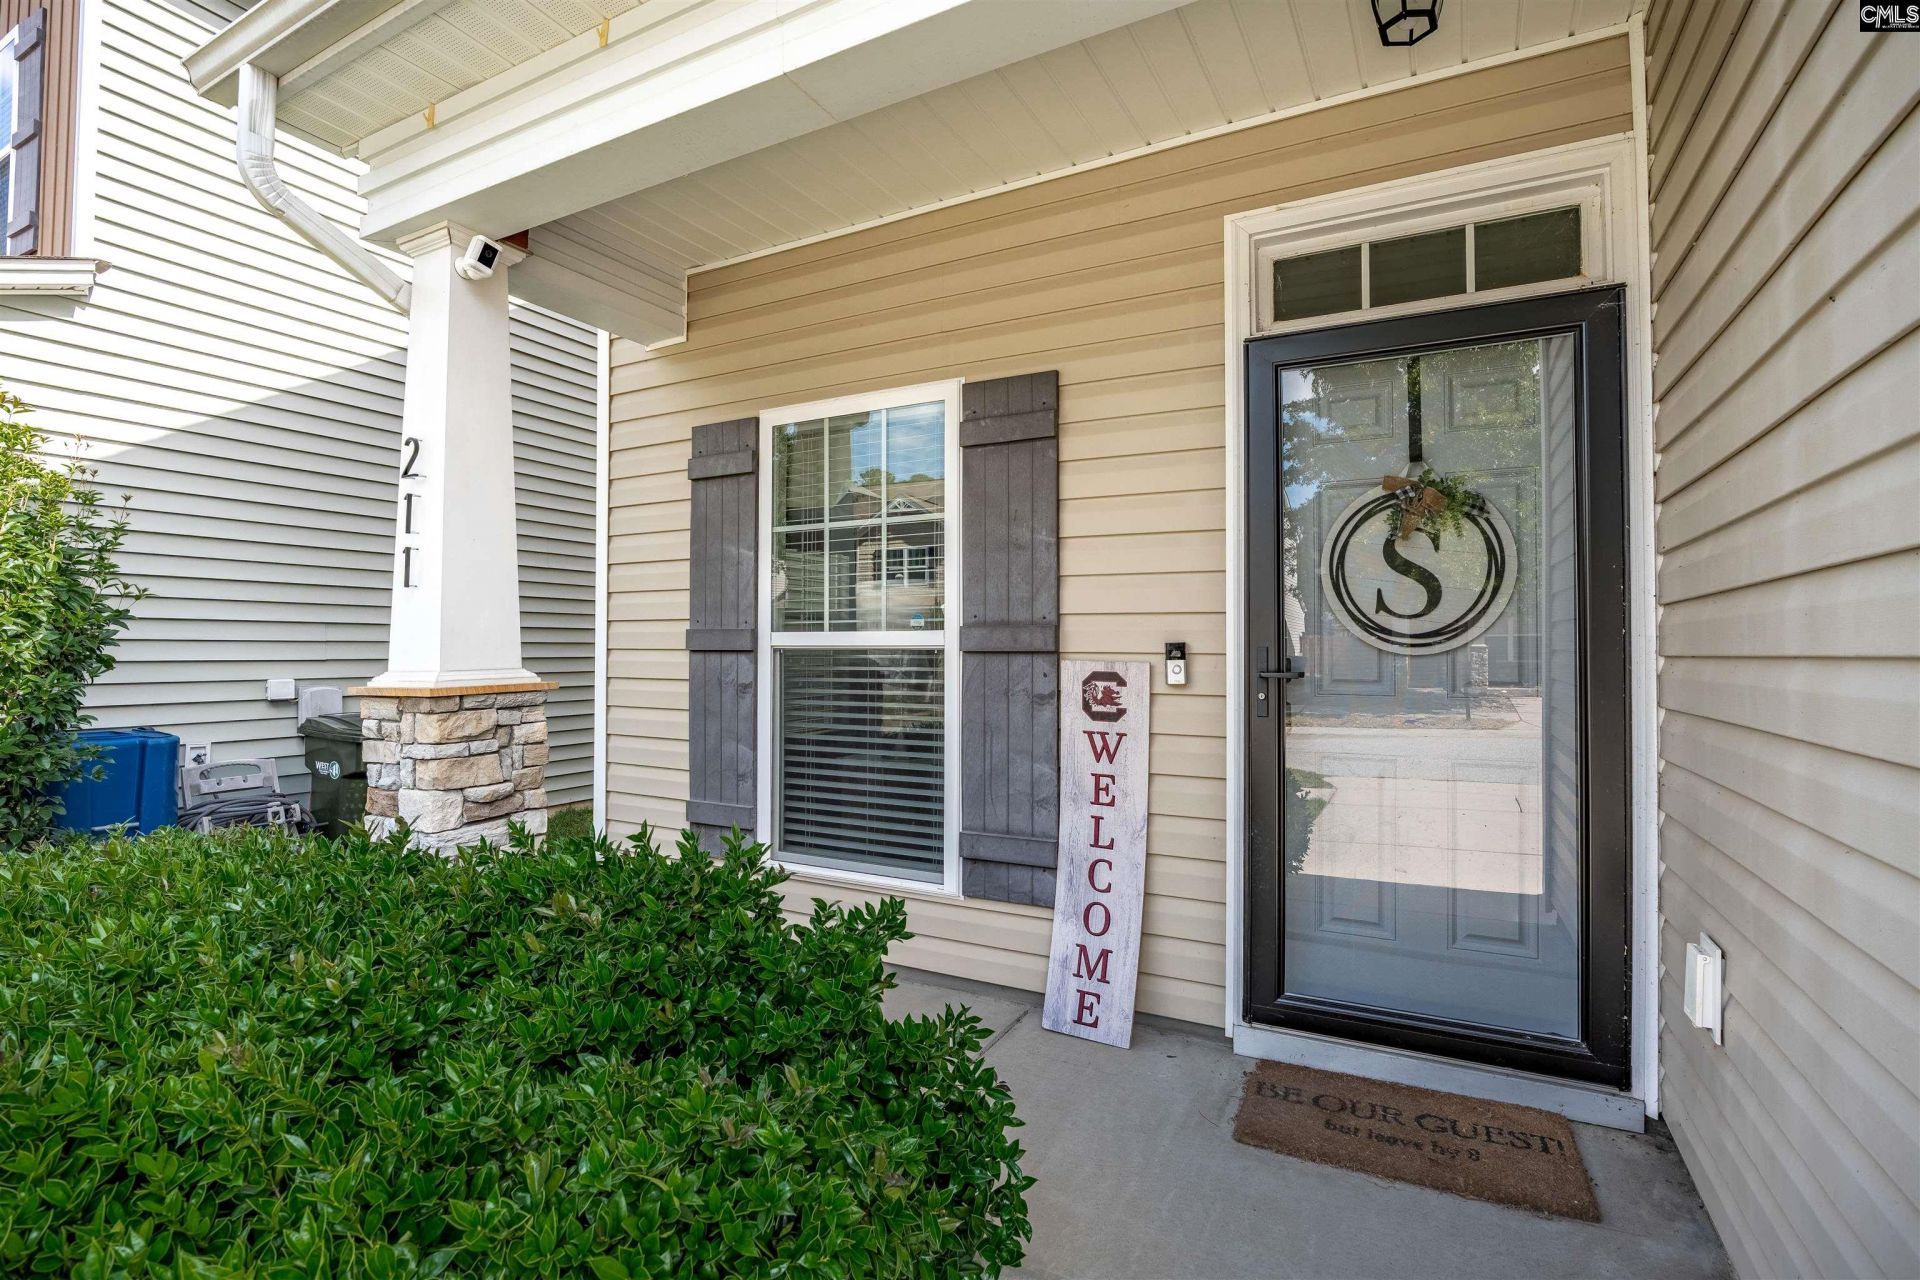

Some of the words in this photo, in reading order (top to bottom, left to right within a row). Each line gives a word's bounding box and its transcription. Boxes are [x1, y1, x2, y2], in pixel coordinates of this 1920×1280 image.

[401, 437, 424, 588] 211
[1375, 527, 1442, 619] S
[315, 760, 329, 770] WEST
[1072, 730, 1127, 1029] WELCOME
[1256, 1080, 1304, 1104] BE
[1312, 1094, 1405, 1125] OUR
[1414, 1112, 1566, 1156] GUEST!
[1325, 1118, 1360, 1136] but
[1367, 1129, 1424, 1150] leave
[1431, 1141, 1460, 1160] by
